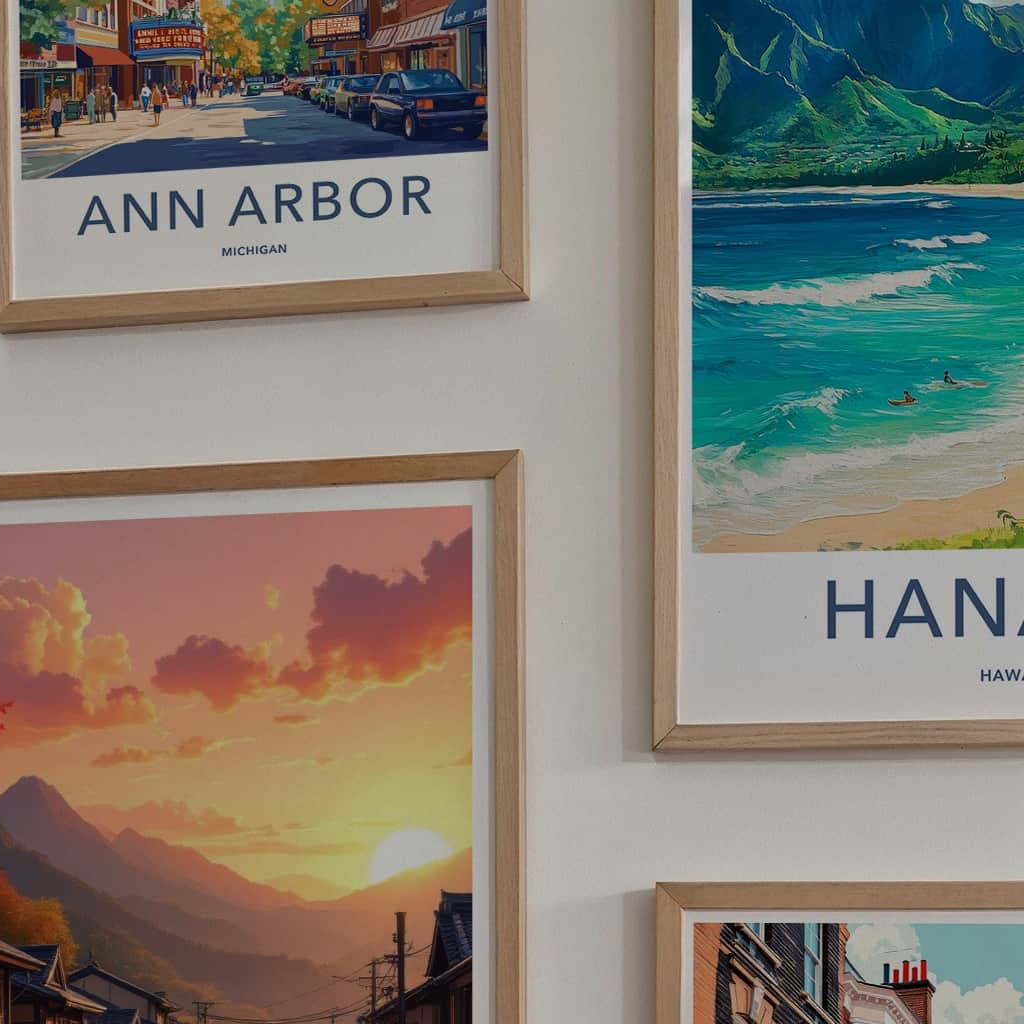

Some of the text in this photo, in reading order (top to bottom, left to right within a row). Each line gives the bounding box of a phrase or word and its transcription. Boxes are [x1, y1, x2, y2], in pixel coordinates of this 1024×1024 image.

[77, 174, 433, 236] ANN ARBOR
[221, 243, 288, 257] MICHIGAN
[827, 577, 1024, 639] HAN
